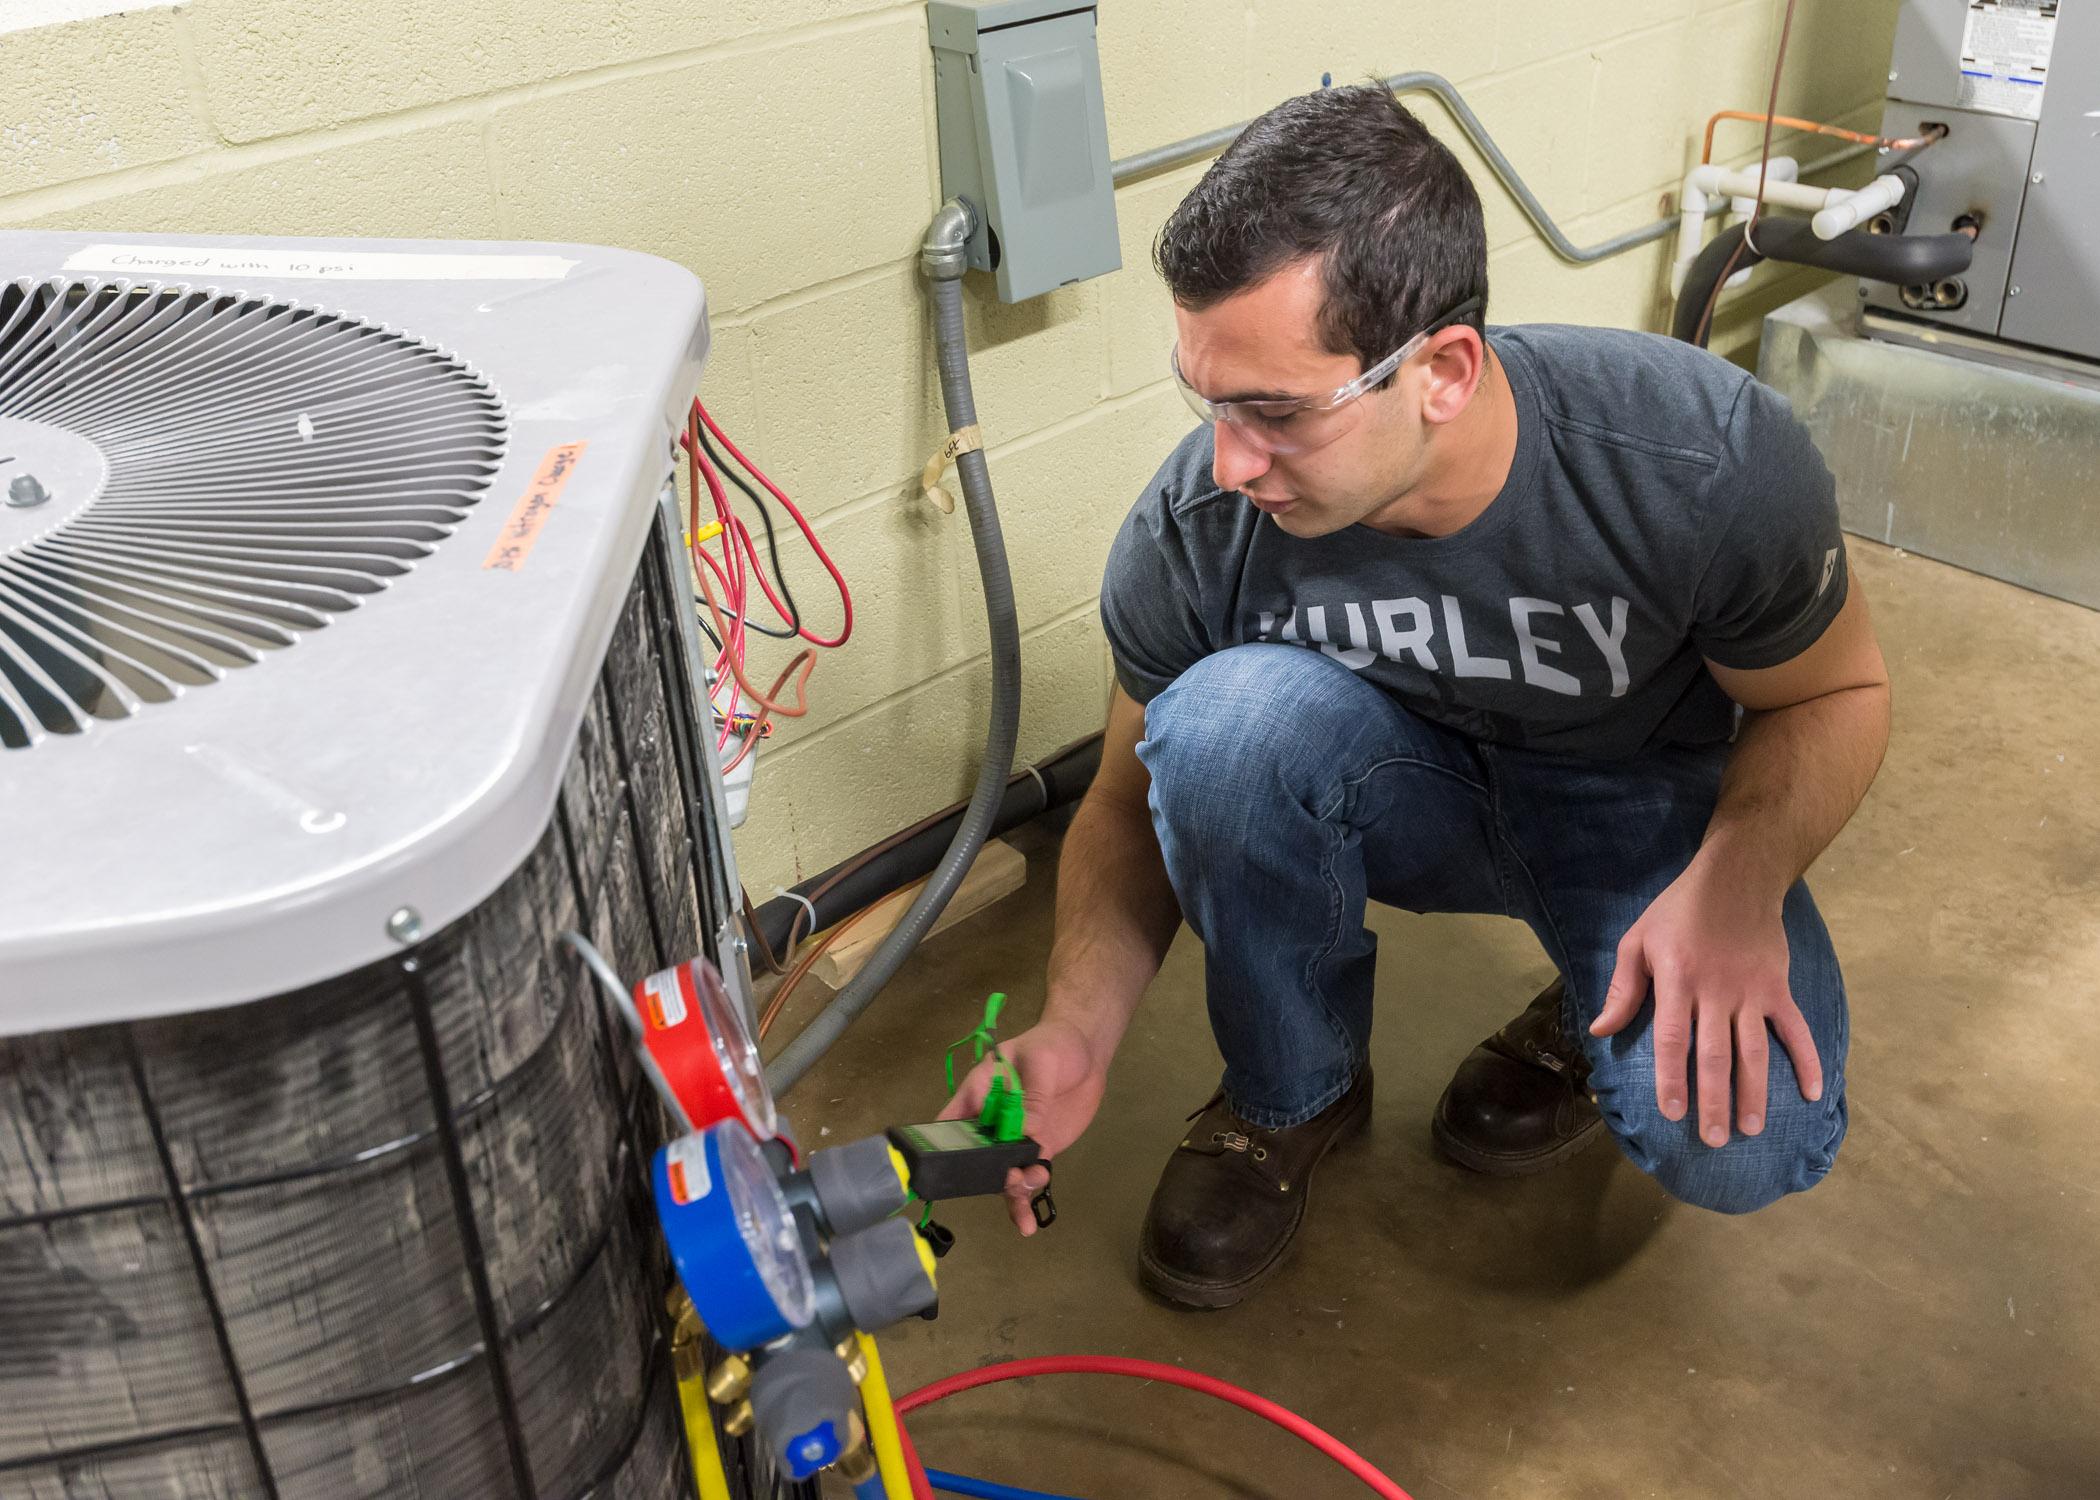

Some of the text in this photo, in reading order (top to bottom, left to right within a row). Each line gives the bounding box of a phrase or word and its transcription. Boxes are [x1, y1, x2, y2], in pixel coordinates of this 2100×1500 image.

[111, 253, 210, 268] Charged
[289, 263, 310, 272] 10
[318, 263, 354, 274] psi
